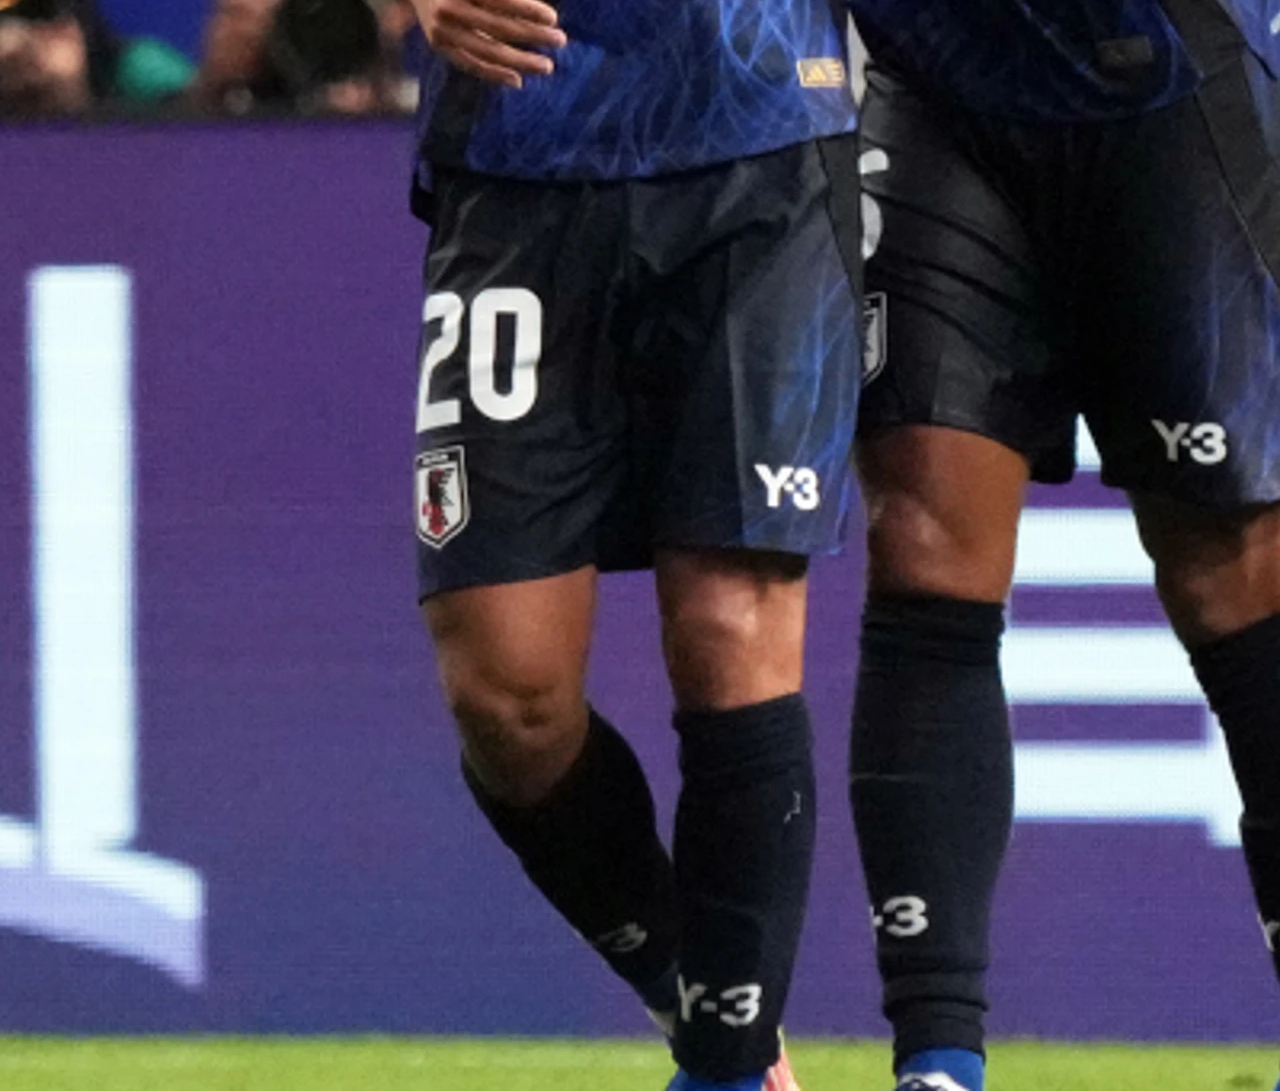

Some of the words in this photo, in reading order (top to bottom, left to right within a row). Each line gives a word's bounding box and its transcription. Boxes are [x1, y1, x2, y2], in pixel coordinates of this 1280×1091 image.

[415, 287, 543, 434] 20
[1151, 418, 1227, 465] Y-3
[753, 463, 820, 511] Y-3
[676, 972, 763, 1027] Y-3
